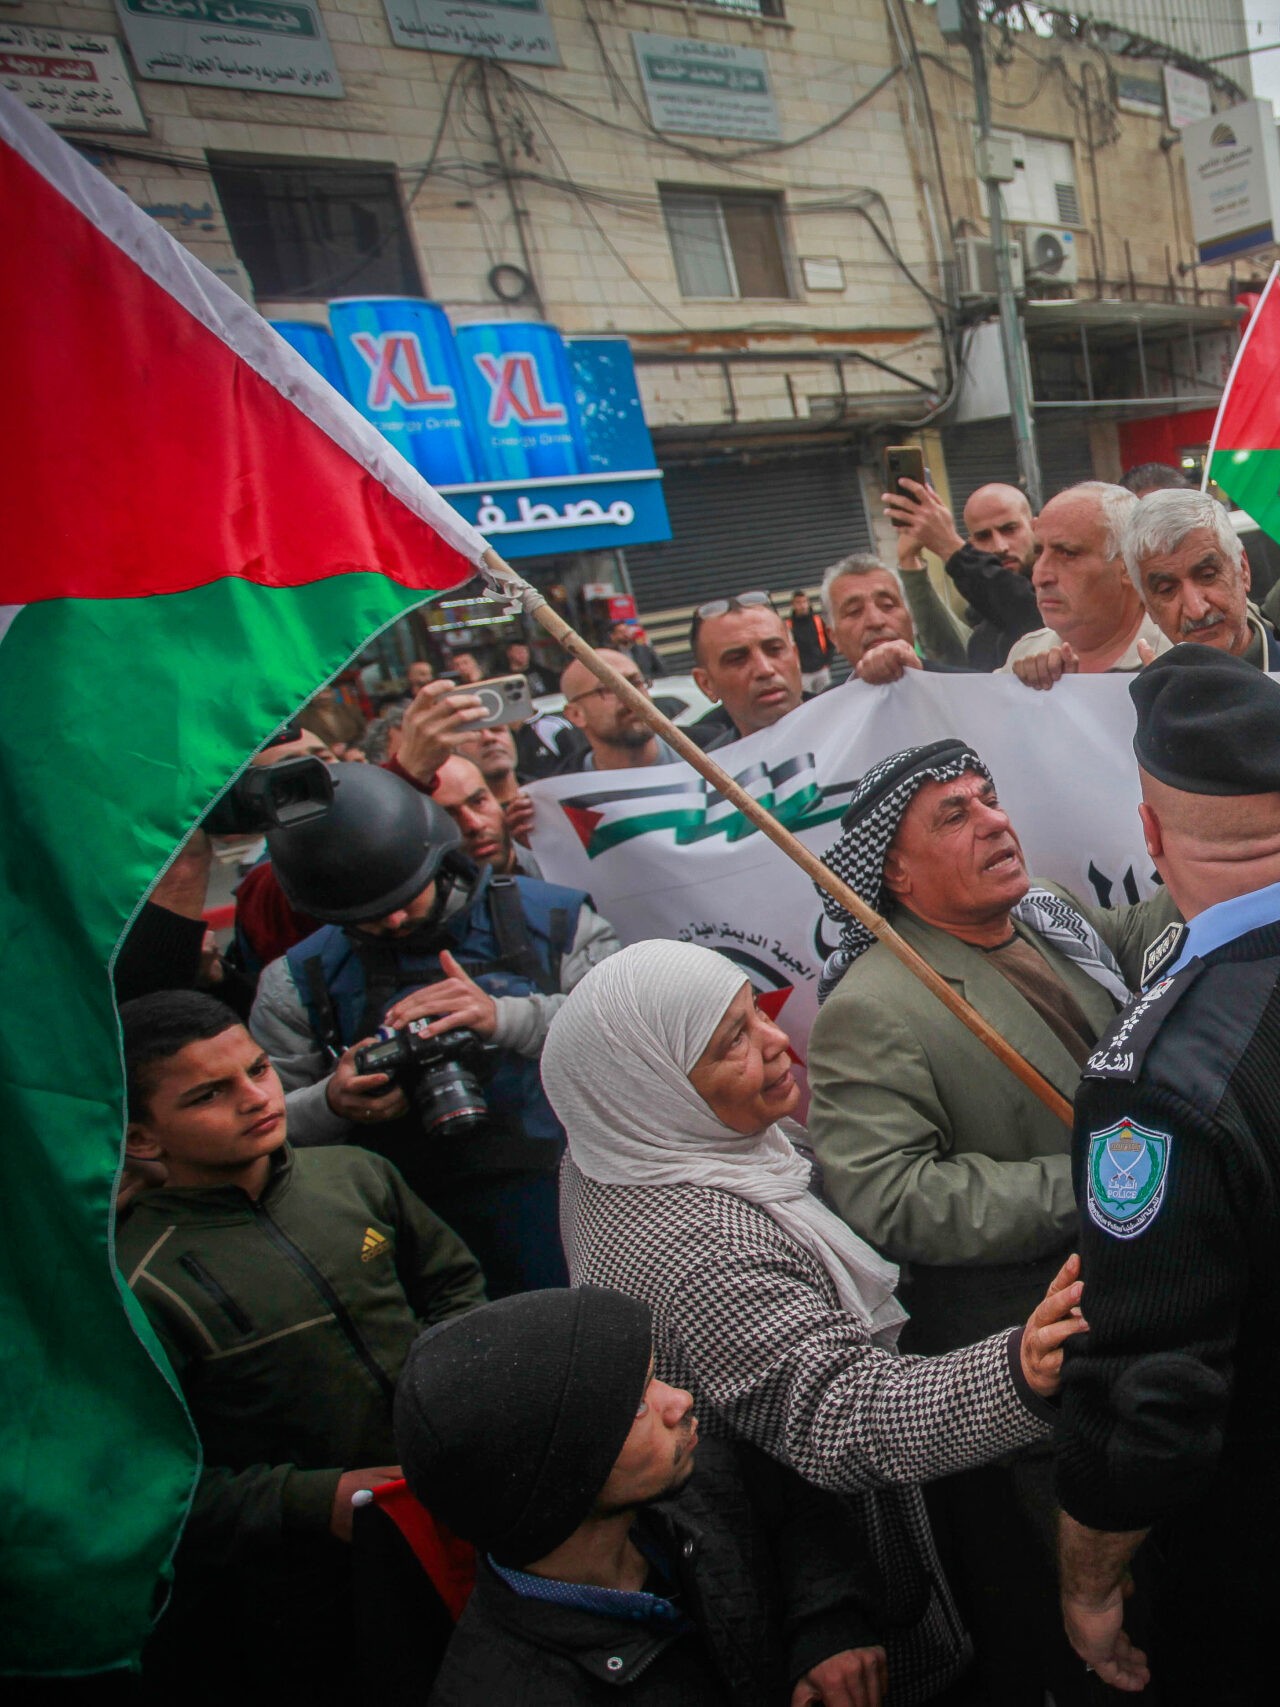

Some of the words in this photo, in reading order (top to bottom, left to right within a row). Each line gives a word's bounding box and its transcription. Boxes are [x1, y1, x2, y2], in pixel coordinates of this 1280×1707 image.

[352, 333, 454, 409] XL
[477, 354, 566, 425] XL
[474, 494, 634, 535] مصطف
[771, 940, 816, 981] الجبهة
[1107, 1190, 1138, 1199] POLICE
